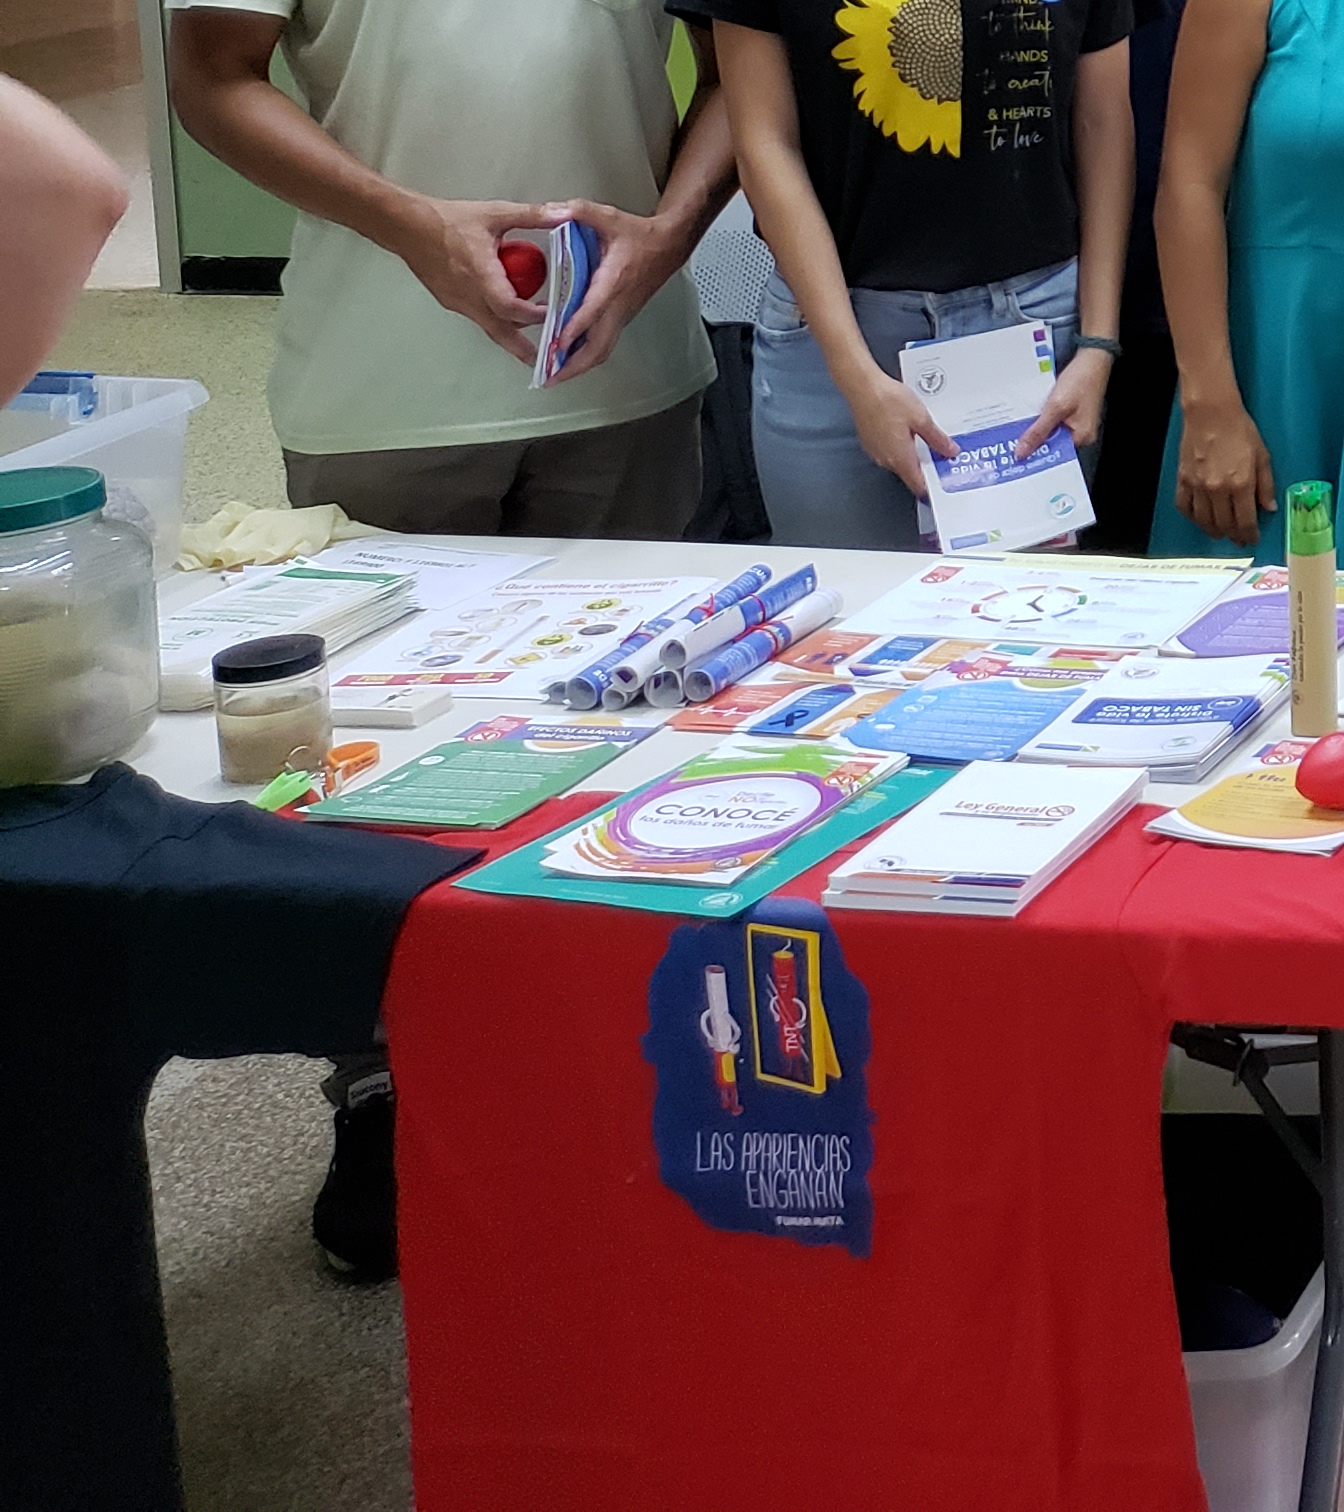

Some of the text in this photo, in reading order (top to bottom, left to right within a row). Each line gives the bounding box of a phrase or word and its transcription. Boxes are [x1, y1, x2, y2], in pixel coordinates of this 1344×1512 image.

[1002, 106, 1052, 120] HEARTS
[534, 582, 590, 590] contiene
[1096, 710, 1213, 720] Disfrute la vida
[1103, 704, 1203, 713] SIN TABACO
[655, 803, 799, 823] CONOCÉ
[954, 800, 984, 812] Ley
[985, 802, 1048, 814] General
[639, 815, 780, 831] los daños de fumar
[696, 1130, 852, 1174] LAS APARIENCIAS
